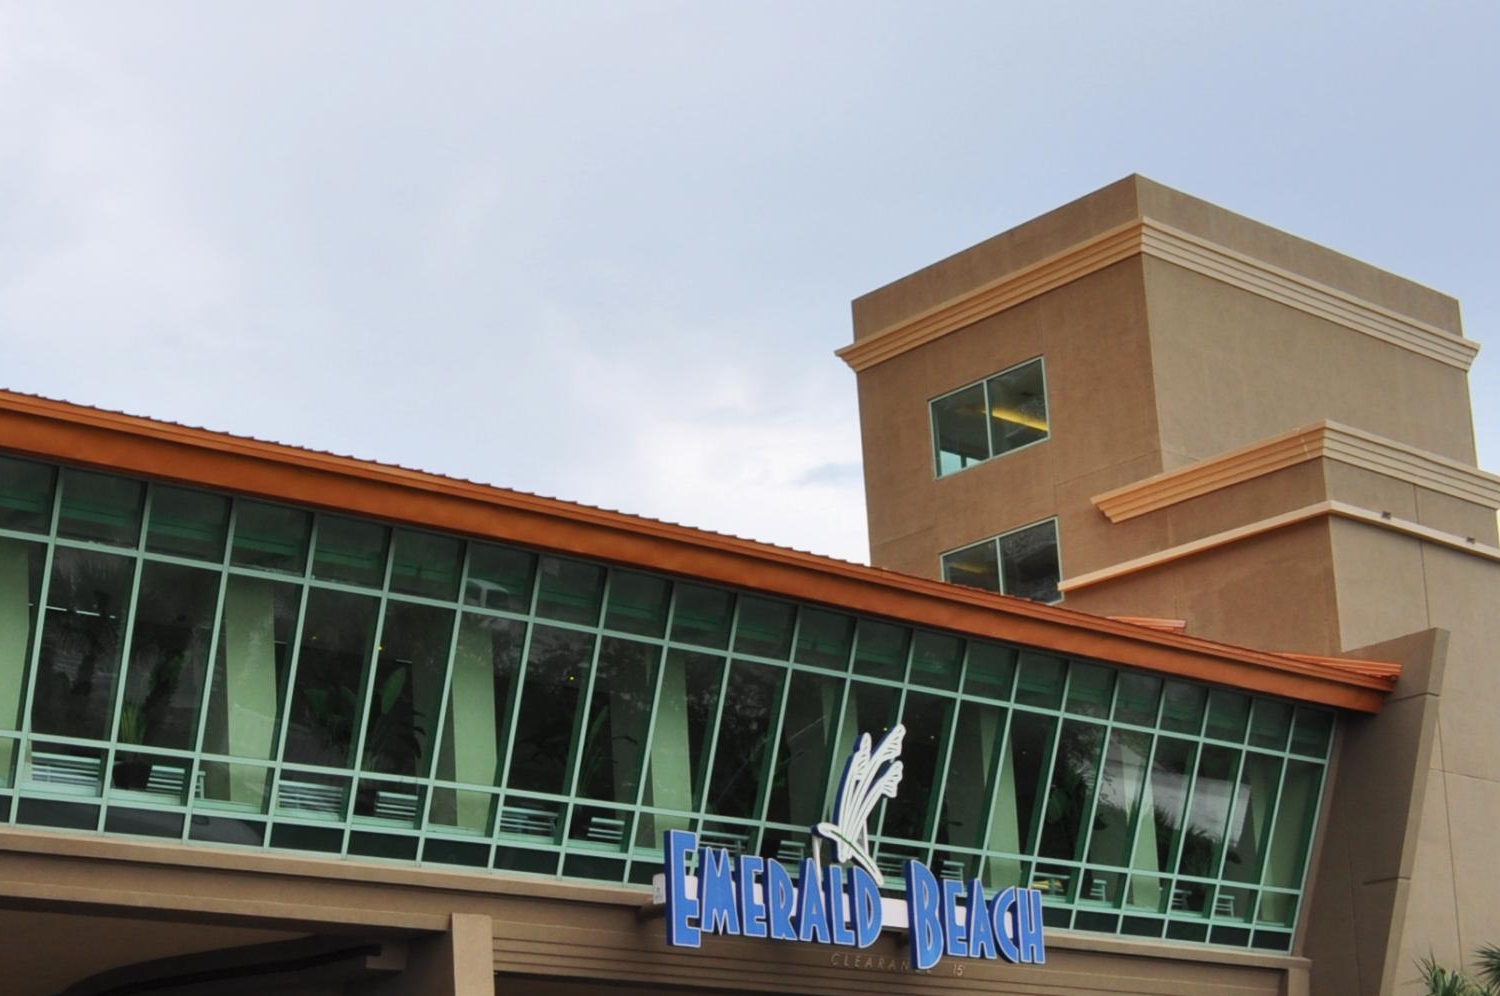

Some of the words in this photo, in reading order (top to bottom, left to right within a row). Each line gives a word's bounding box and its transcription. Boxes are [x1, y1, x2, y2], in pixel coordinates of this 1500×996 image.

[664, 829, 884, 949] EMERALD
[905, 858, 1046, 970] BEACH
[830, 952, 931, 974] CLEARAN
